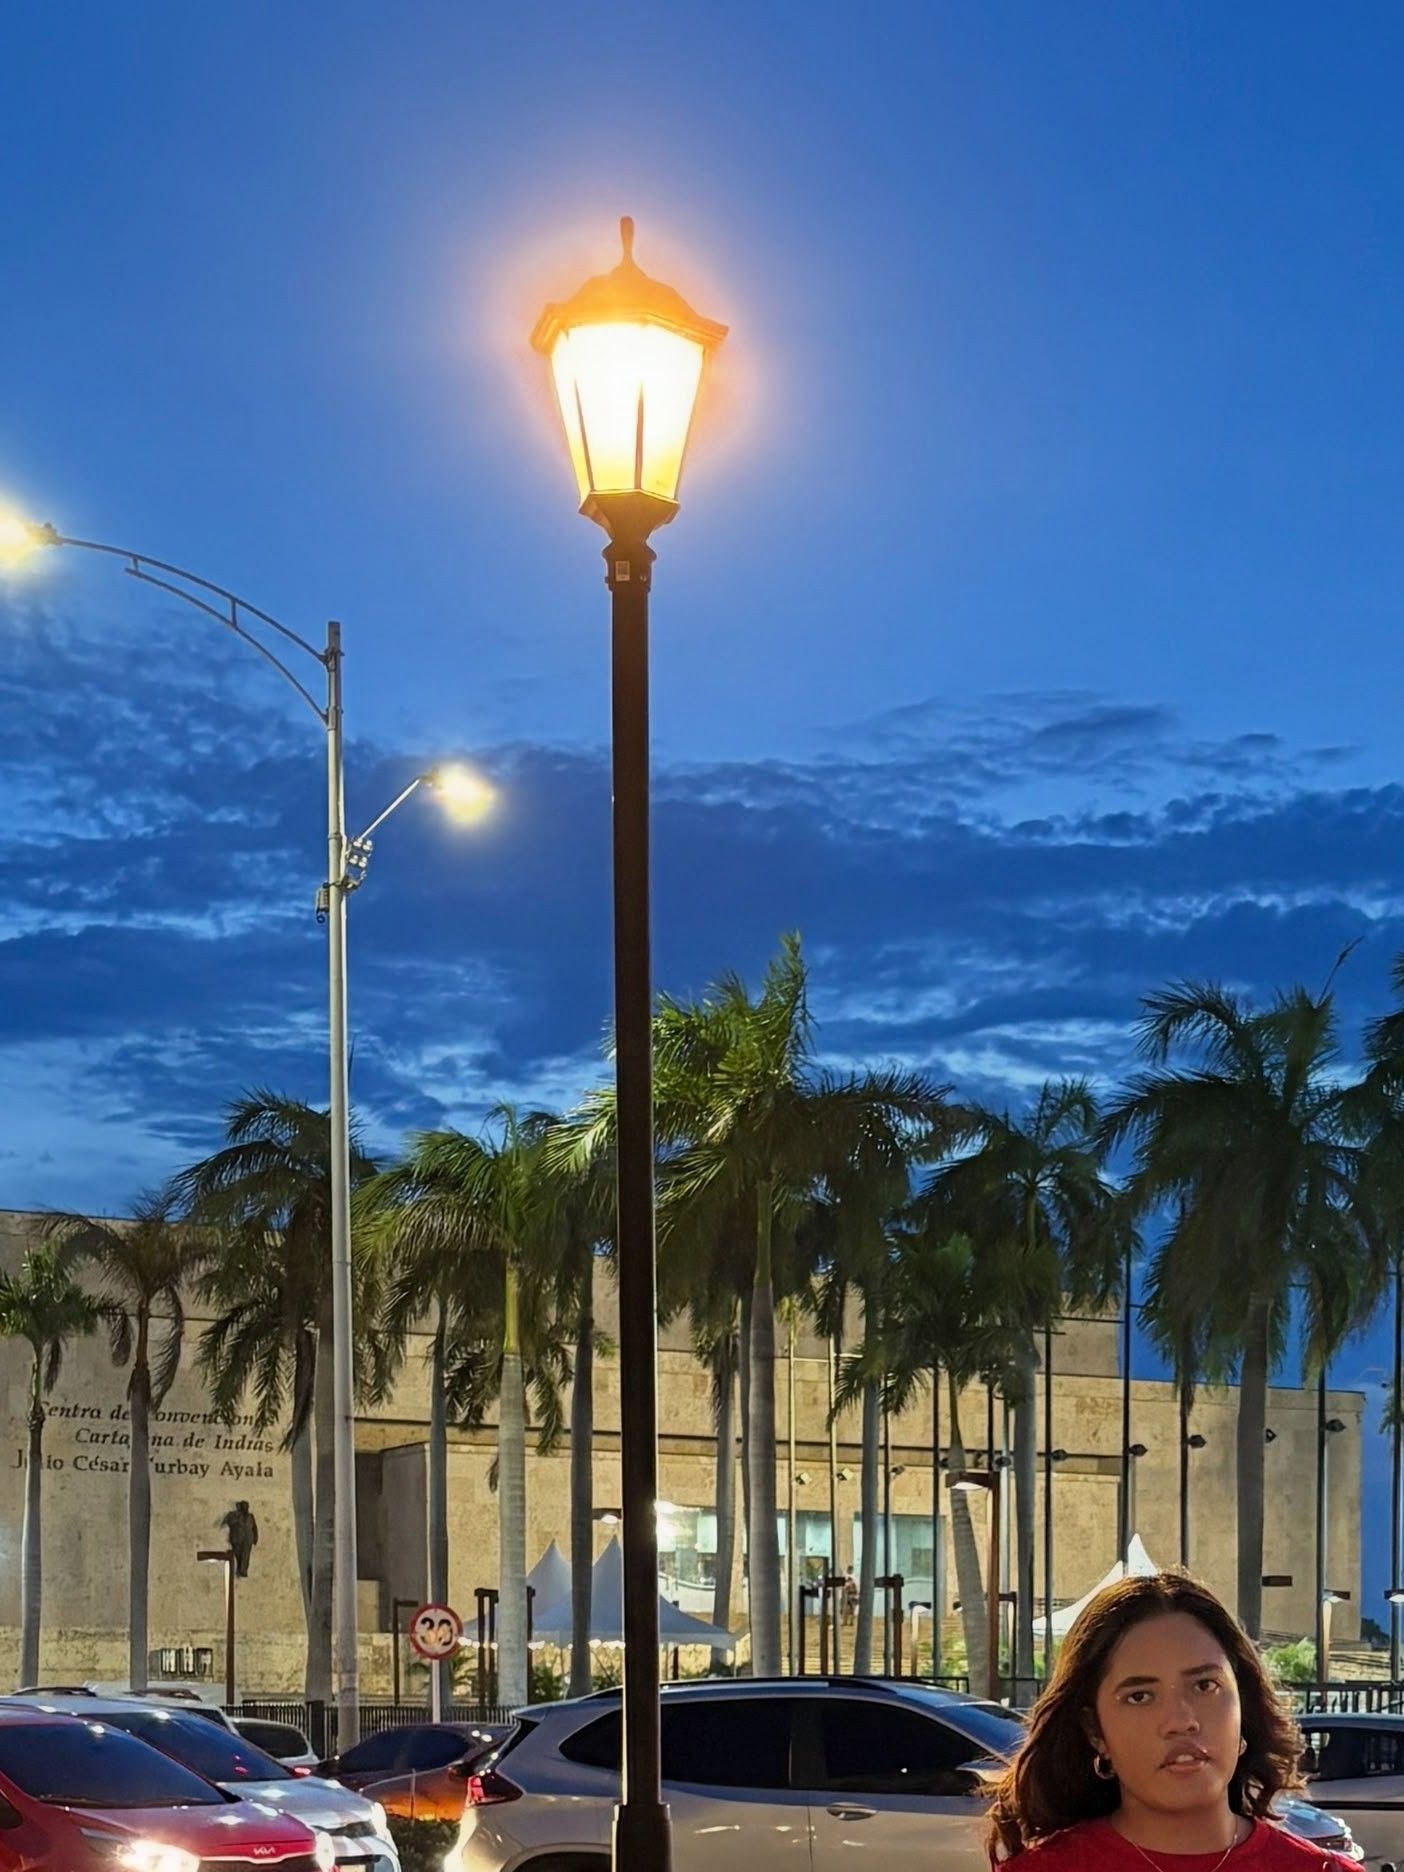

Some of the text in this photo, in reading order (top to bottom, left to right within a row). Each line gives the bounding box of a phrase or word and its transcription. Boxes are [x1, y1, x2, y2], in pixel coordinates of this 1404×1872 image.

[183, 1432, 205, 1449] de
[214, 1434, 274, 1453] Indias
[149, 1456, 210, 1478] urbay
[220, 1461, 274, 1480] Ayala
